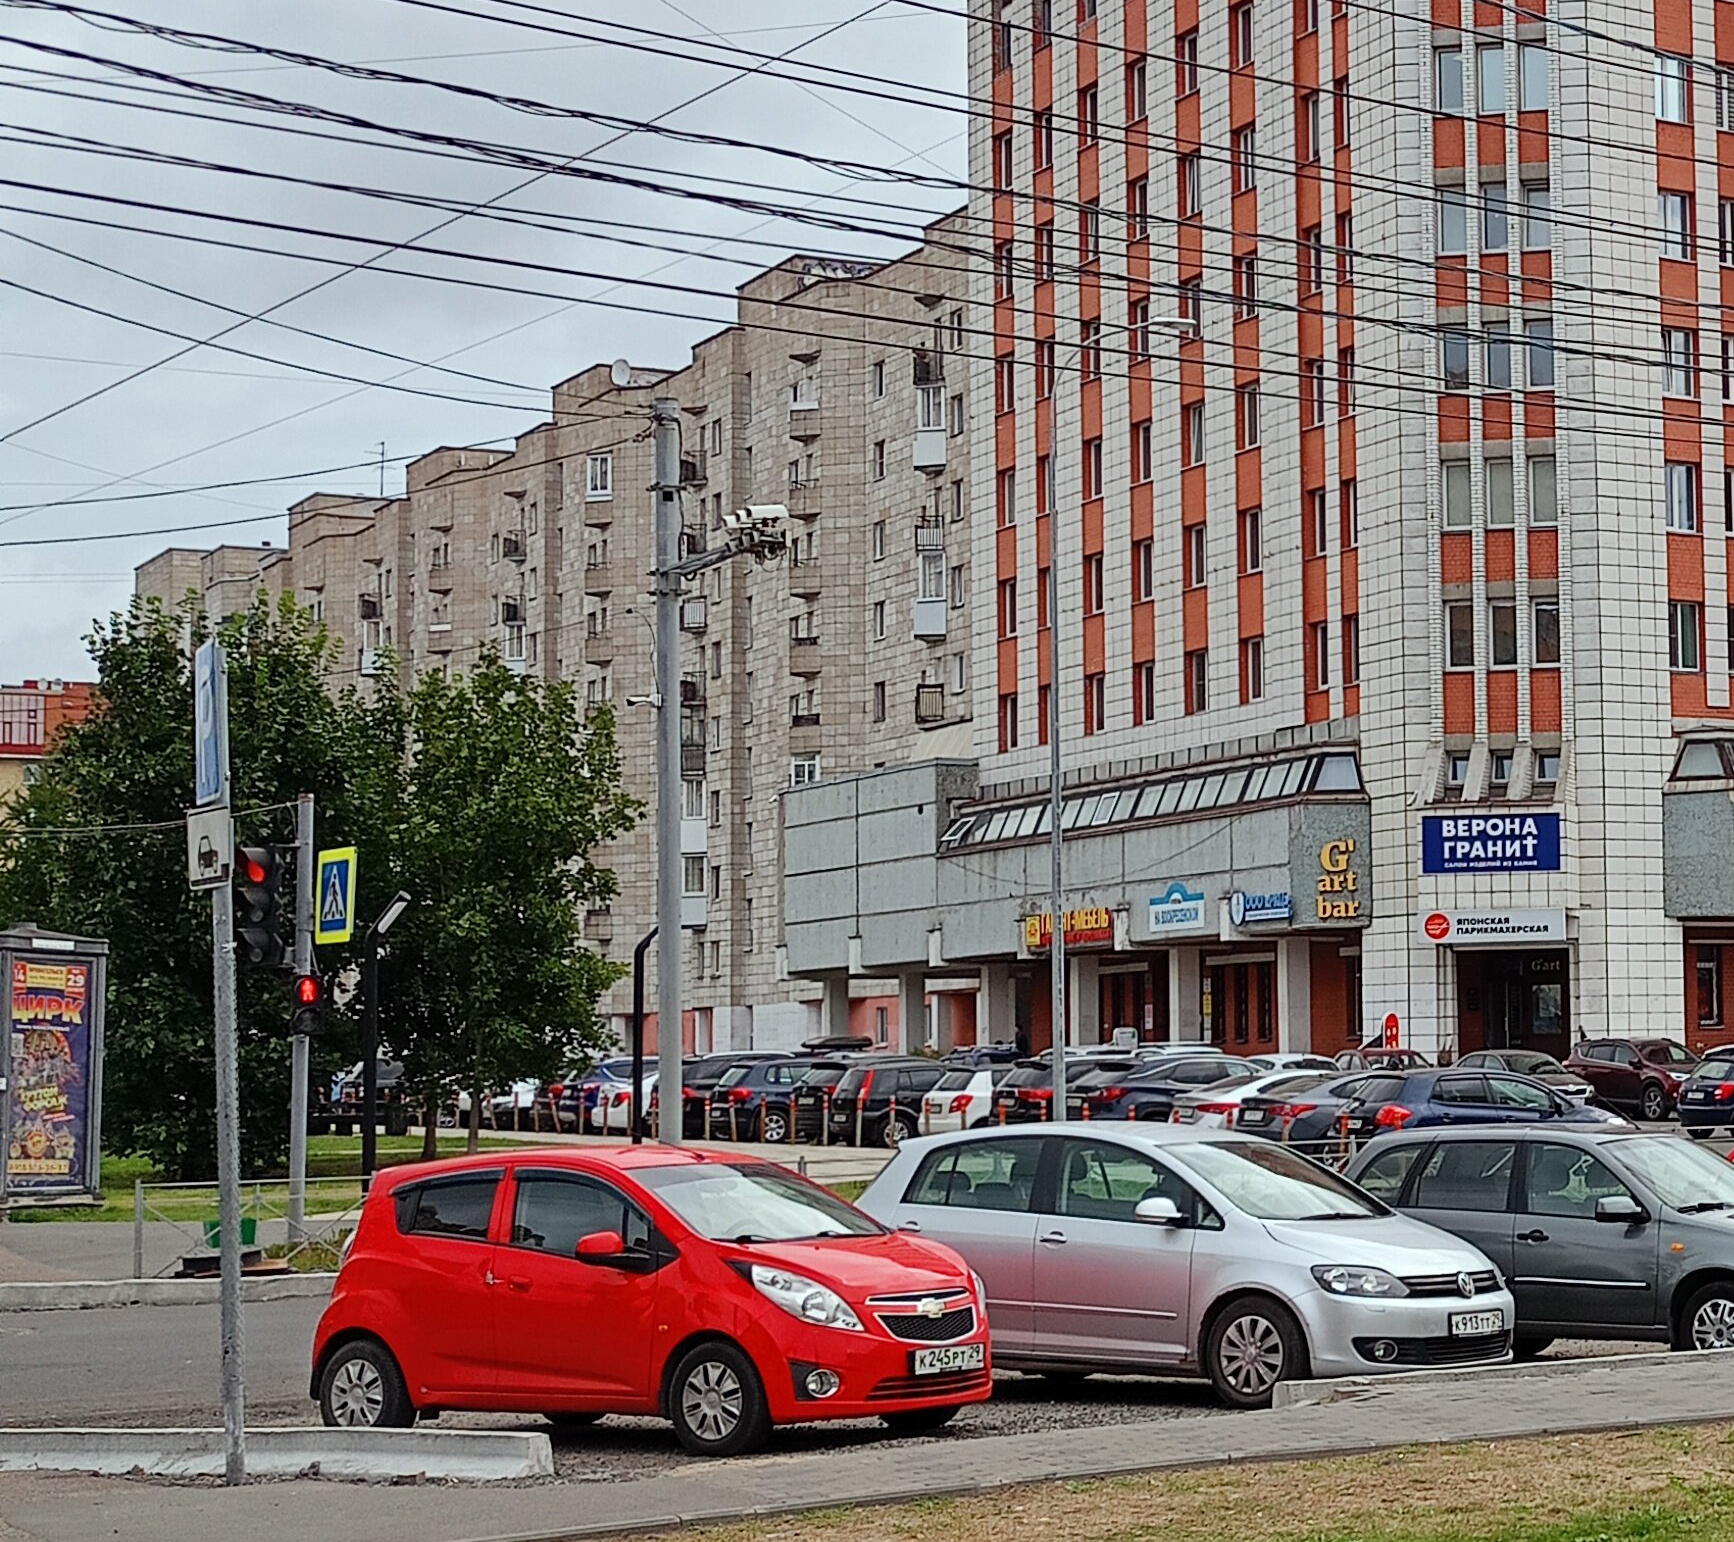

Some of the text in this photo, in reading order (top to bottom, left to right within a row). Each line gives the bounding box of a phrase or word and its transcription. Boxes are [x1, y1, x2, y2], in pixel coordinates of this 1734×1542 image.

[1441, 817, 1539, 838] ВЕРОНА
[1443, 836, 1538, 859] ГРАНИТ
[1317, 870, 1358, 892] art
[1316, 895, 1359, 919] bar
[1456, 917, 1510, 926] ЯПОНСКАЯ
[1456, 925, 1549, 936] ПАРИКМАХЕРСКАЯ
[66, 974, 86, 987] 29
[11, 994, 85, 1025] ЦИРК
[919, 1348, 966, 1369] К245РТ
